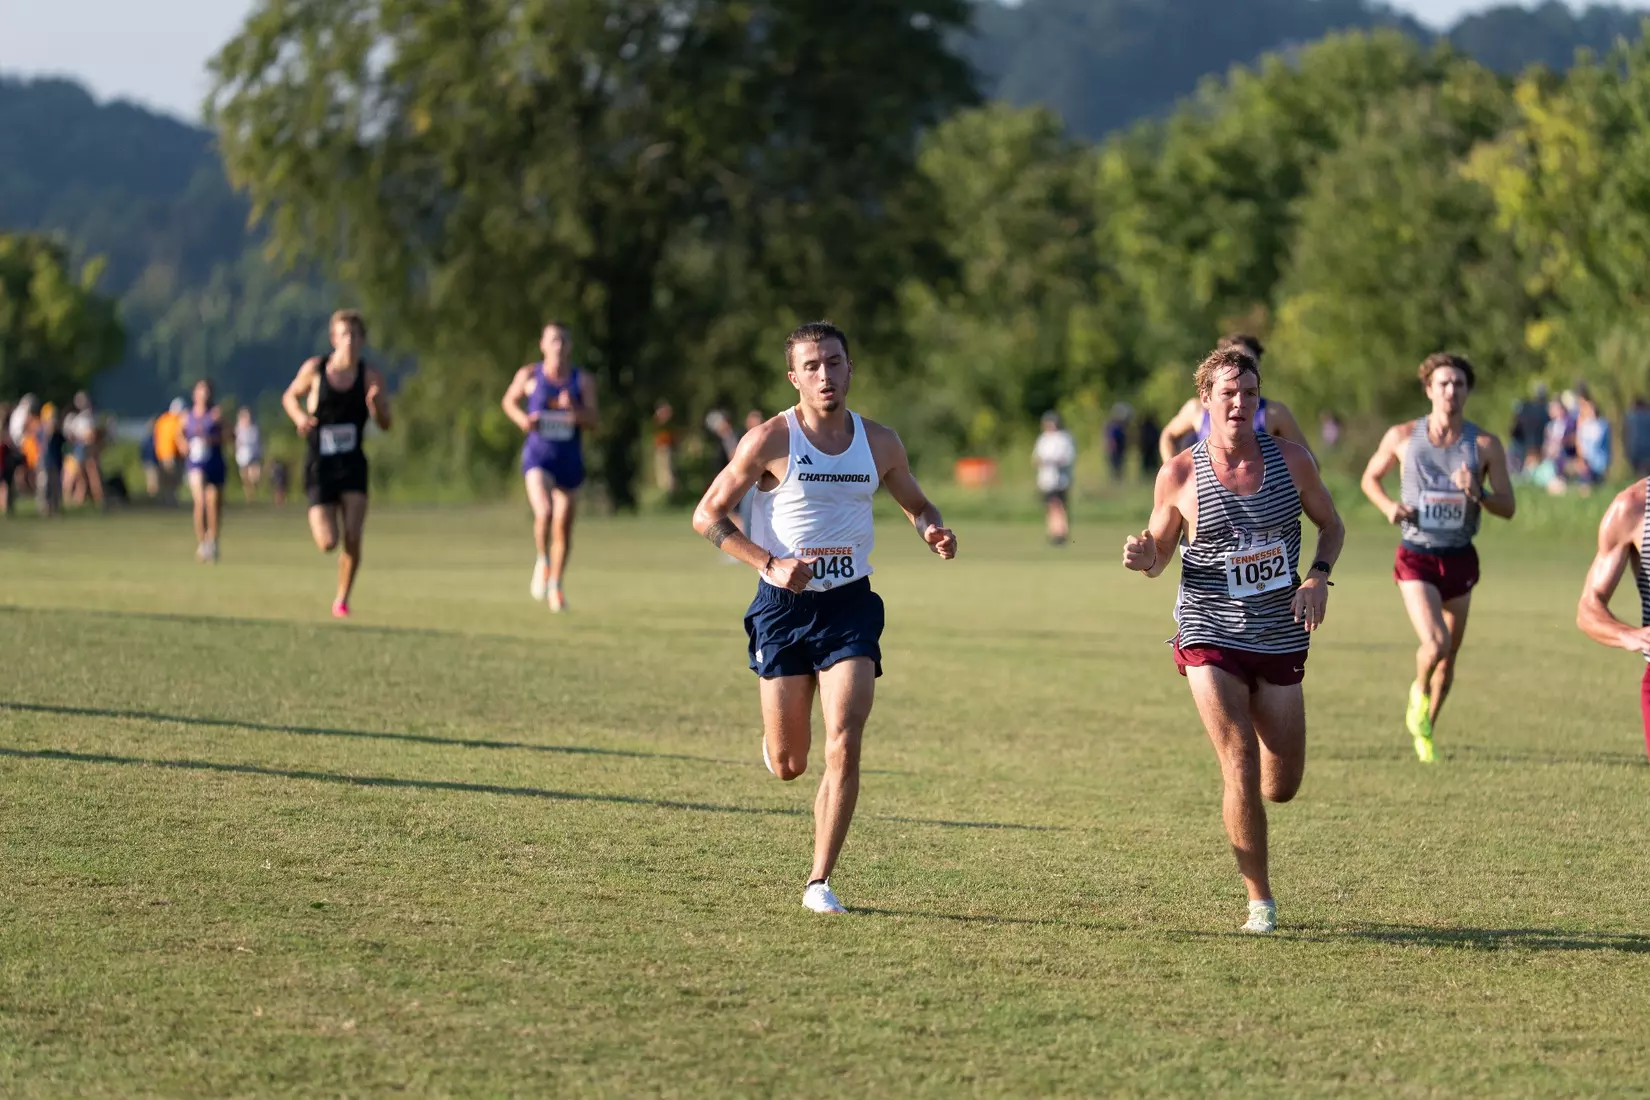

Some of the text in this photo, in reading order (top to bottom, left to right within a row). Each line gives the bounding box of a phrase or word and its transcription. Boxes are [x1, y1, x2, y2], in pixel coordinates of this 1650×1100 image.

[798, 472, 871, 483] CHATTANOOGA
[1424, 504, 1462, 521] 1055
[799, 546, 853, 556] TENNESSEE
[1230, 545, 1282, 565] TENNESSEE
[812, 556, 855, 580] 048
[1230, 555, 1287, 586] 1052
